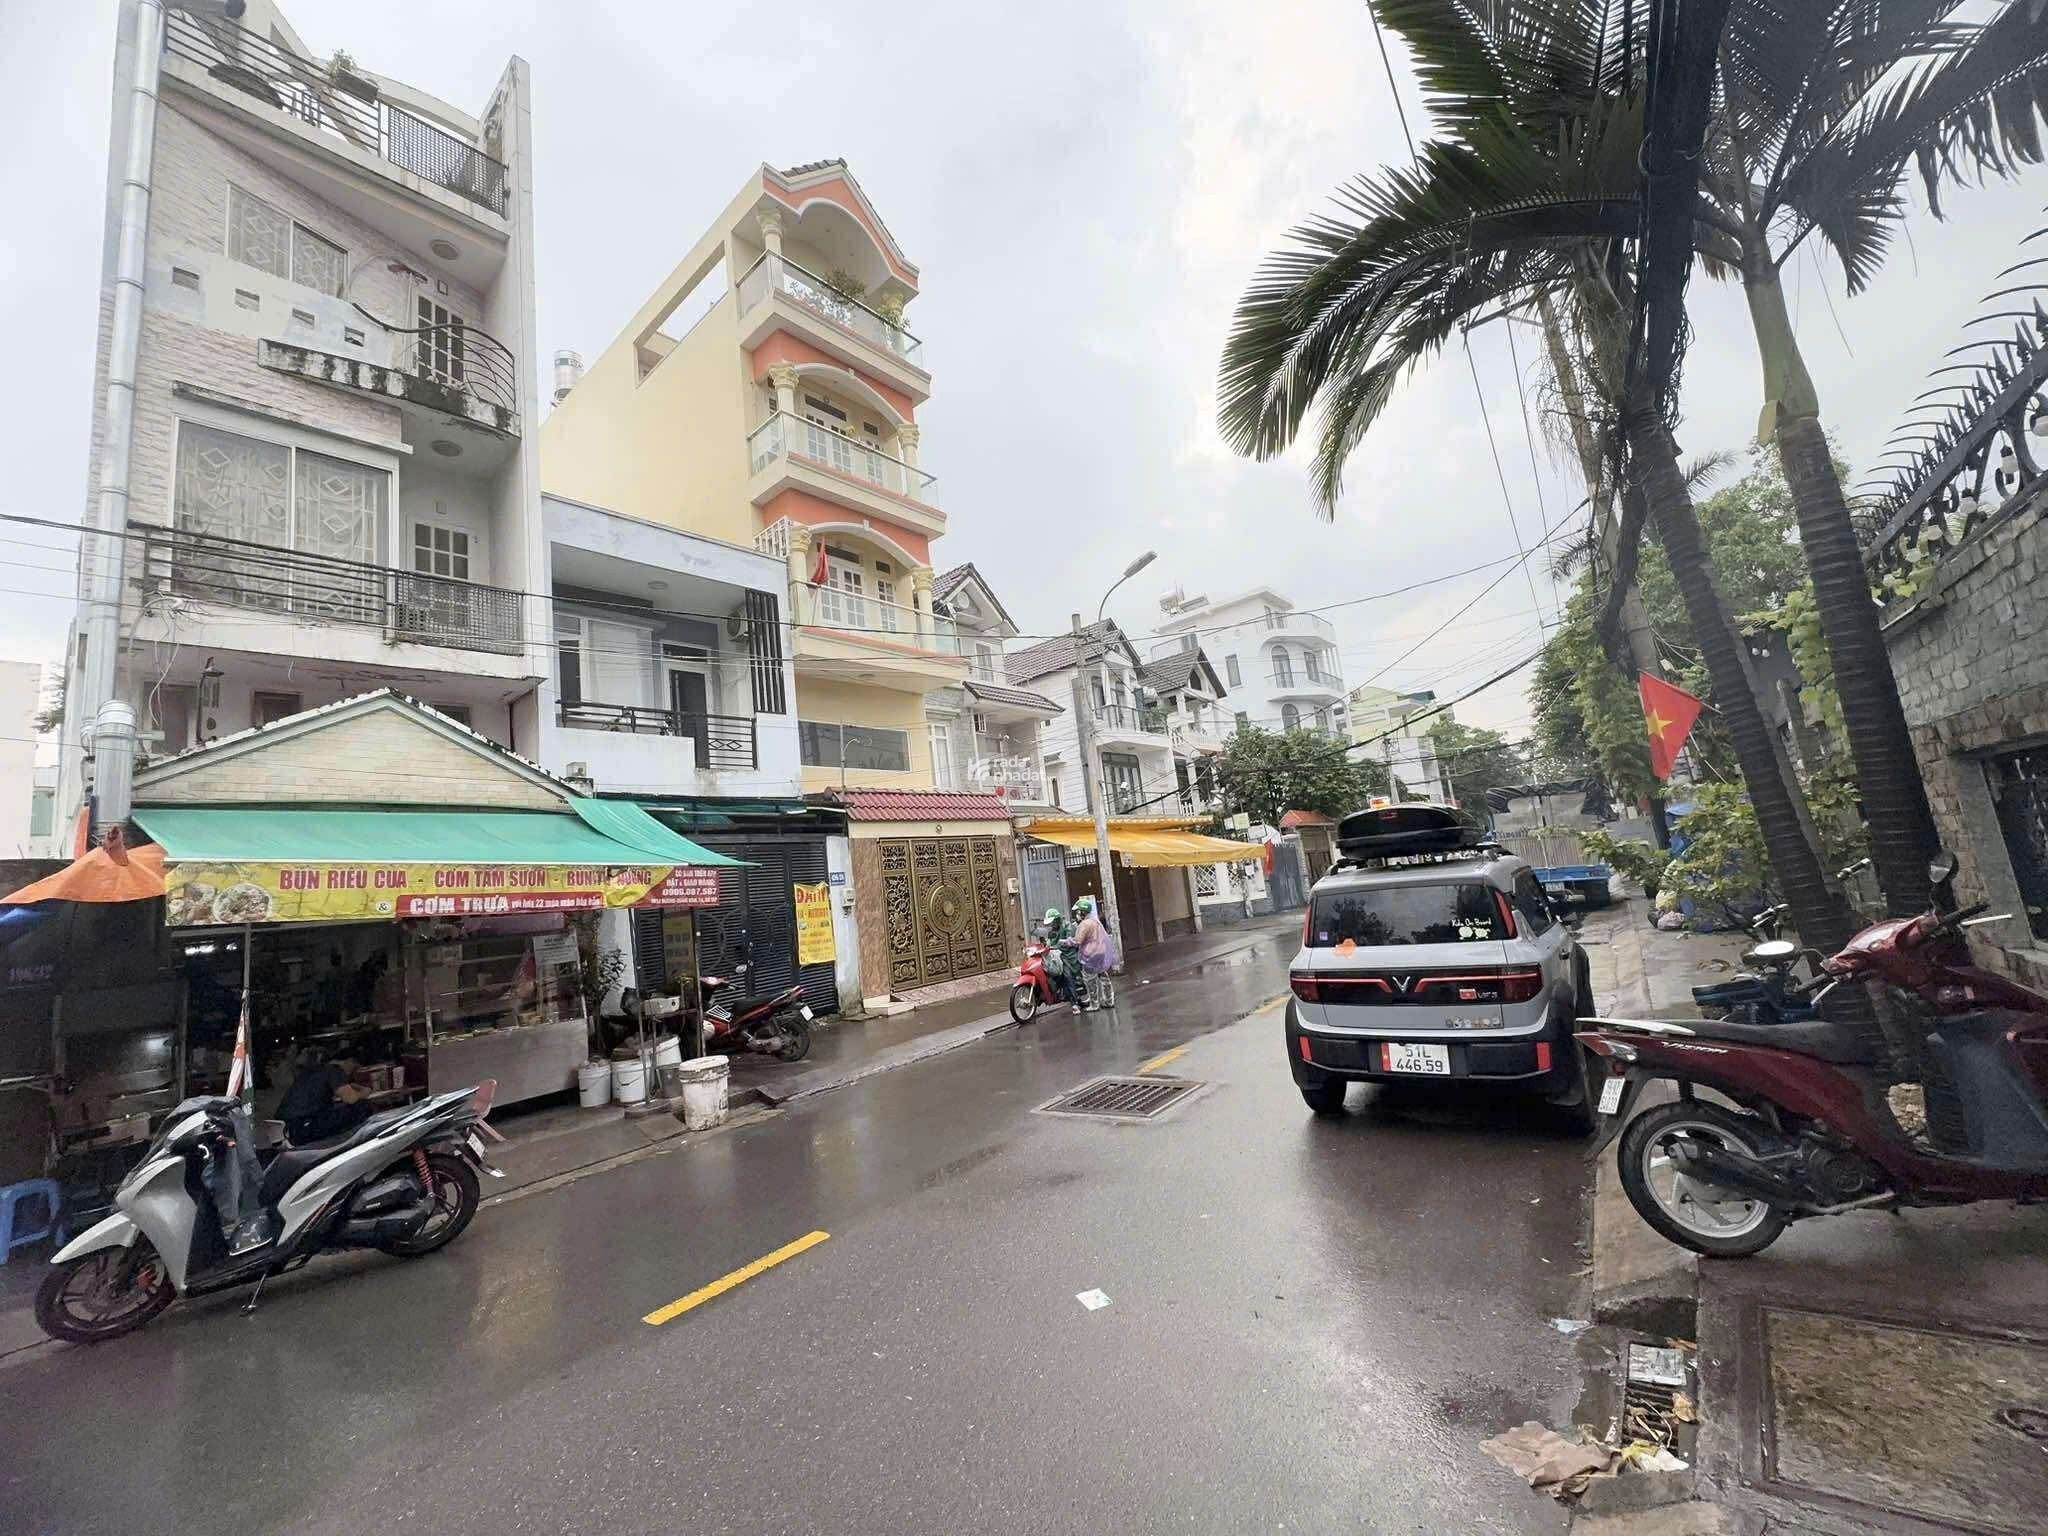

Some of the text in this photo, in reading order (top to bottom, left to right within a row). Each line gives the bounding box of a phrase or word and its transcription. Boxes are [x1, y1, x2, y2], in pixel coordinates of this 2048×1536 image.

[374, 869, 408, 889] CUA
[409, 896, 455, 915] CƠM
[461, 895, 509, 913] TRƯA
[1406, 1046, 1432, 1058] 51L
[1396, 1058, 1443, 1072] 446.59
